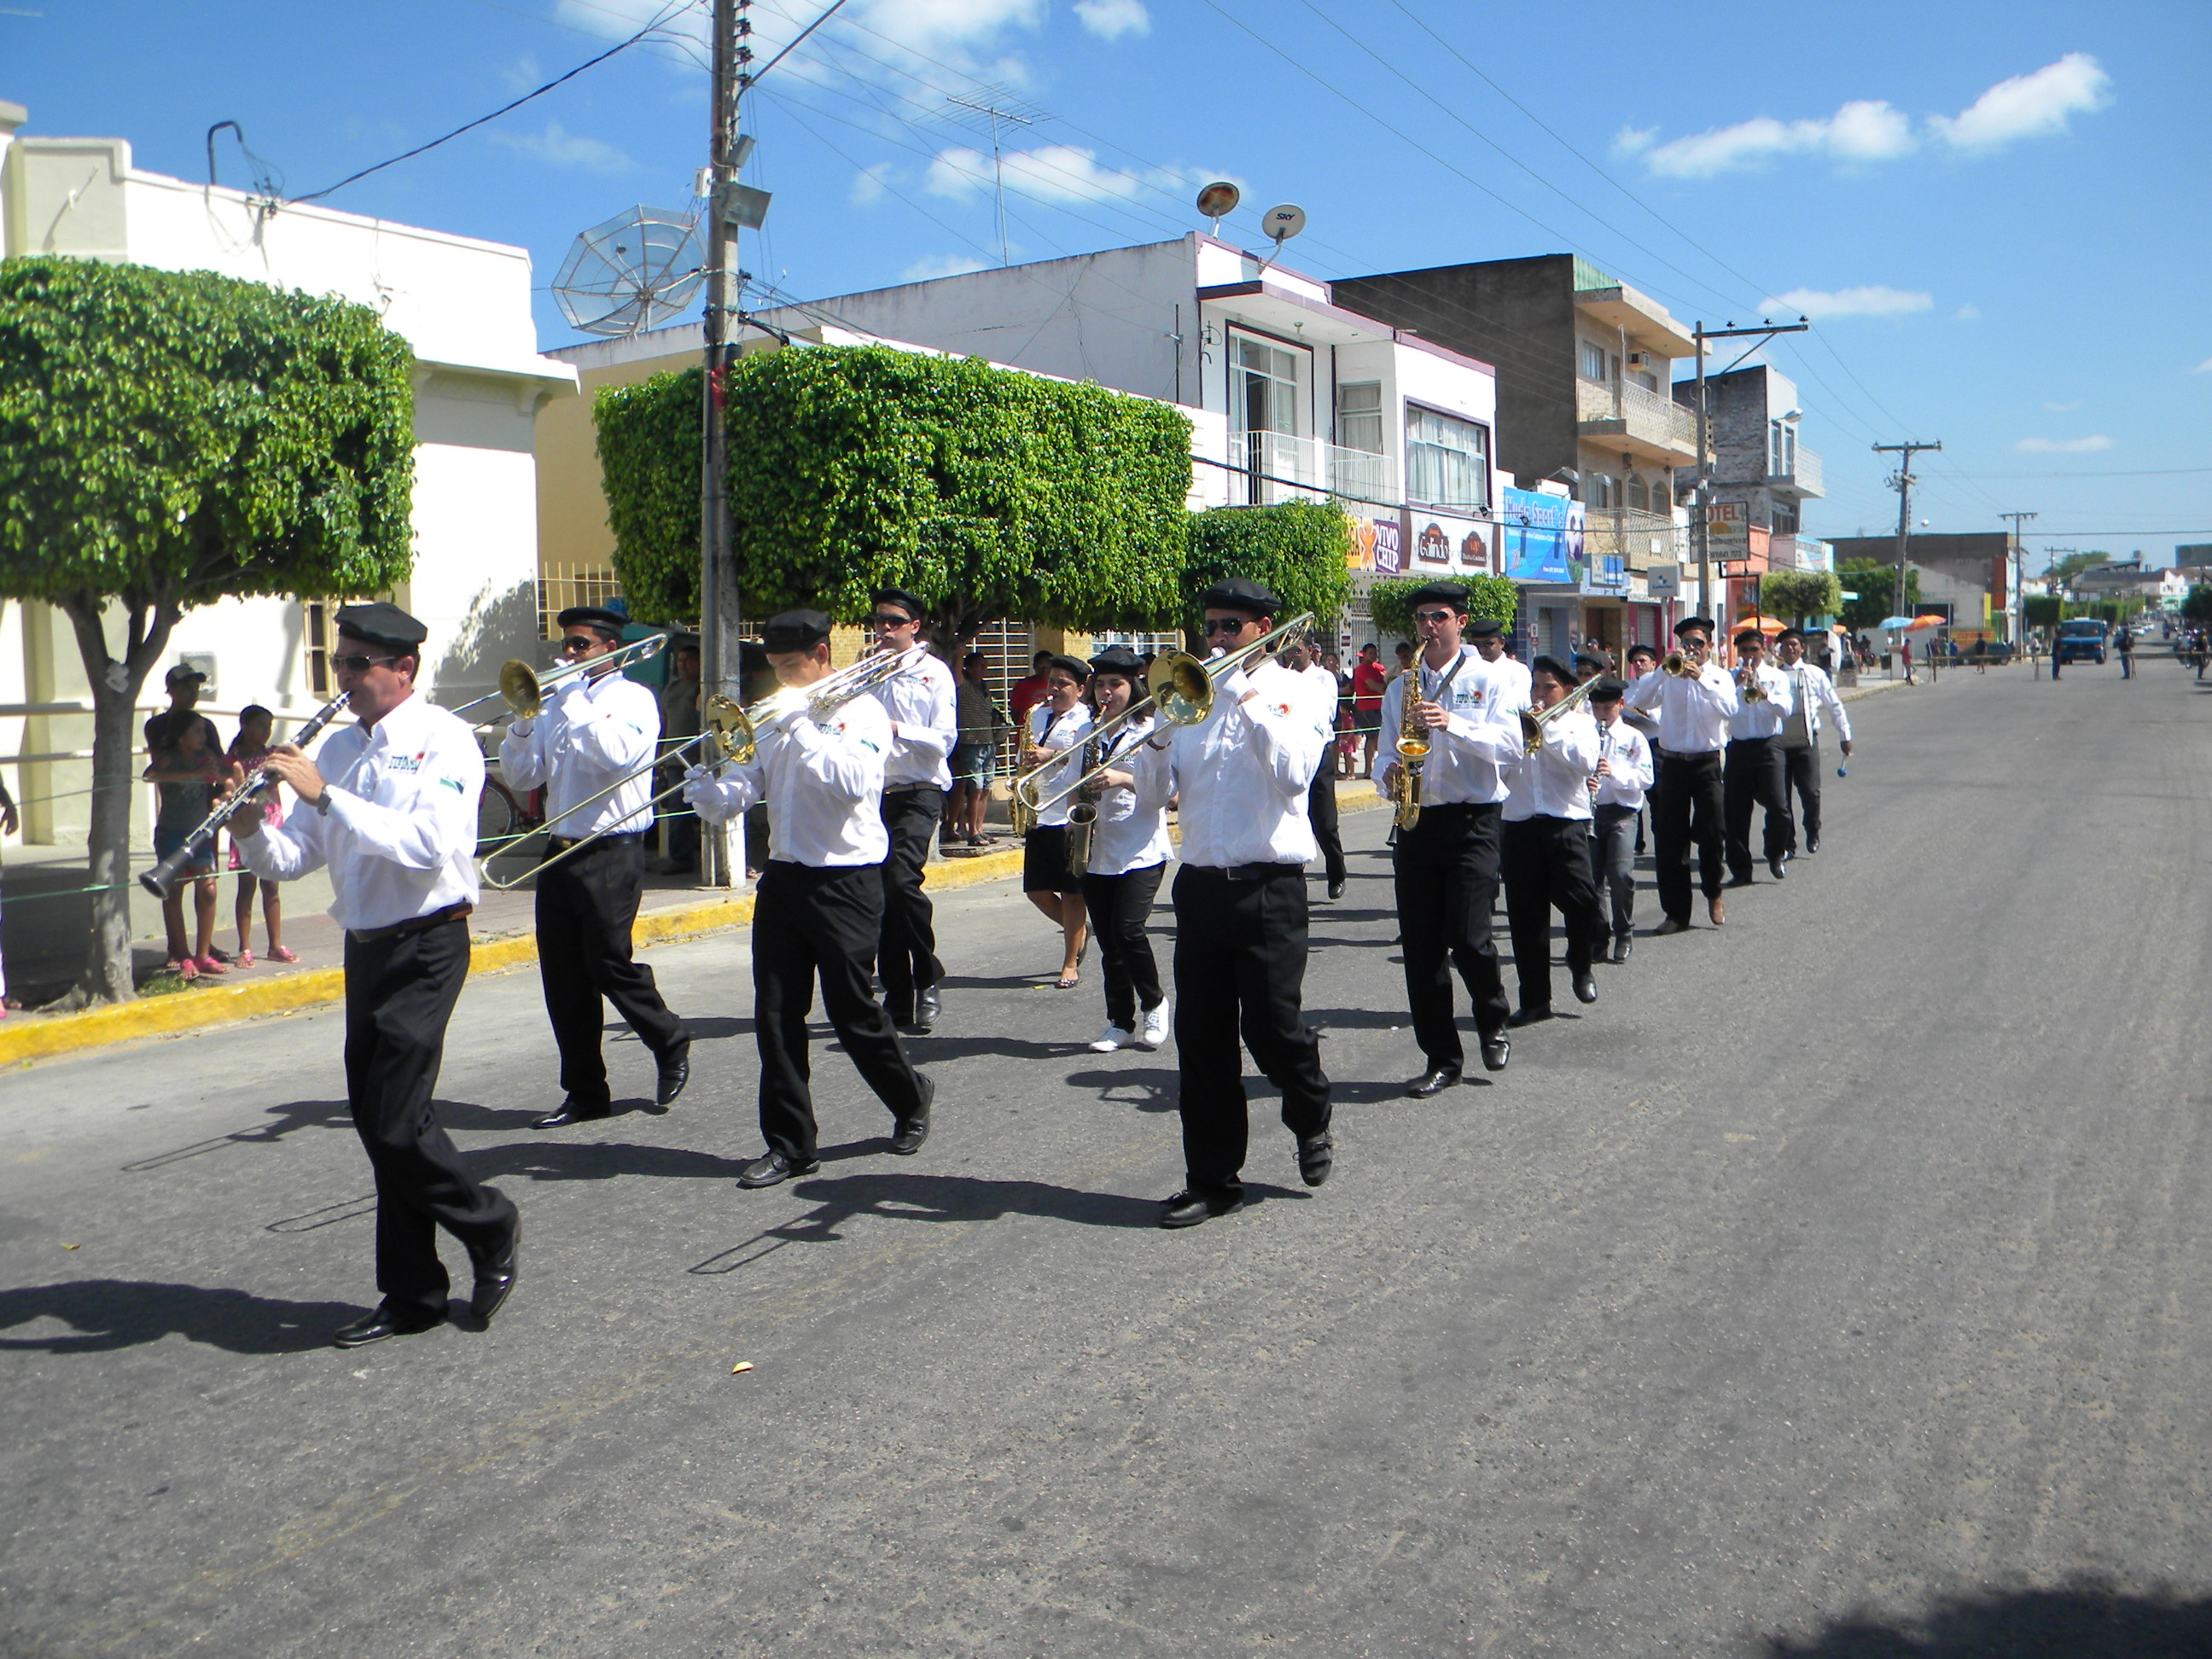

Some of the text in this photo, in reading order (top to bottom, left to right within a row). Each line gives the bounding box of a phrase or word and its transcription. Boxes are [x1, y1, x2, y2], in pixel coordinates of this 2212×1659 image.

[1708, 504, 1739, 521] OTEL
[1377, 524, 1399, 550] VIVO
[1420, 535, 1448, 560] Galindo
[1377, 545, 1399, 573] CHIP
